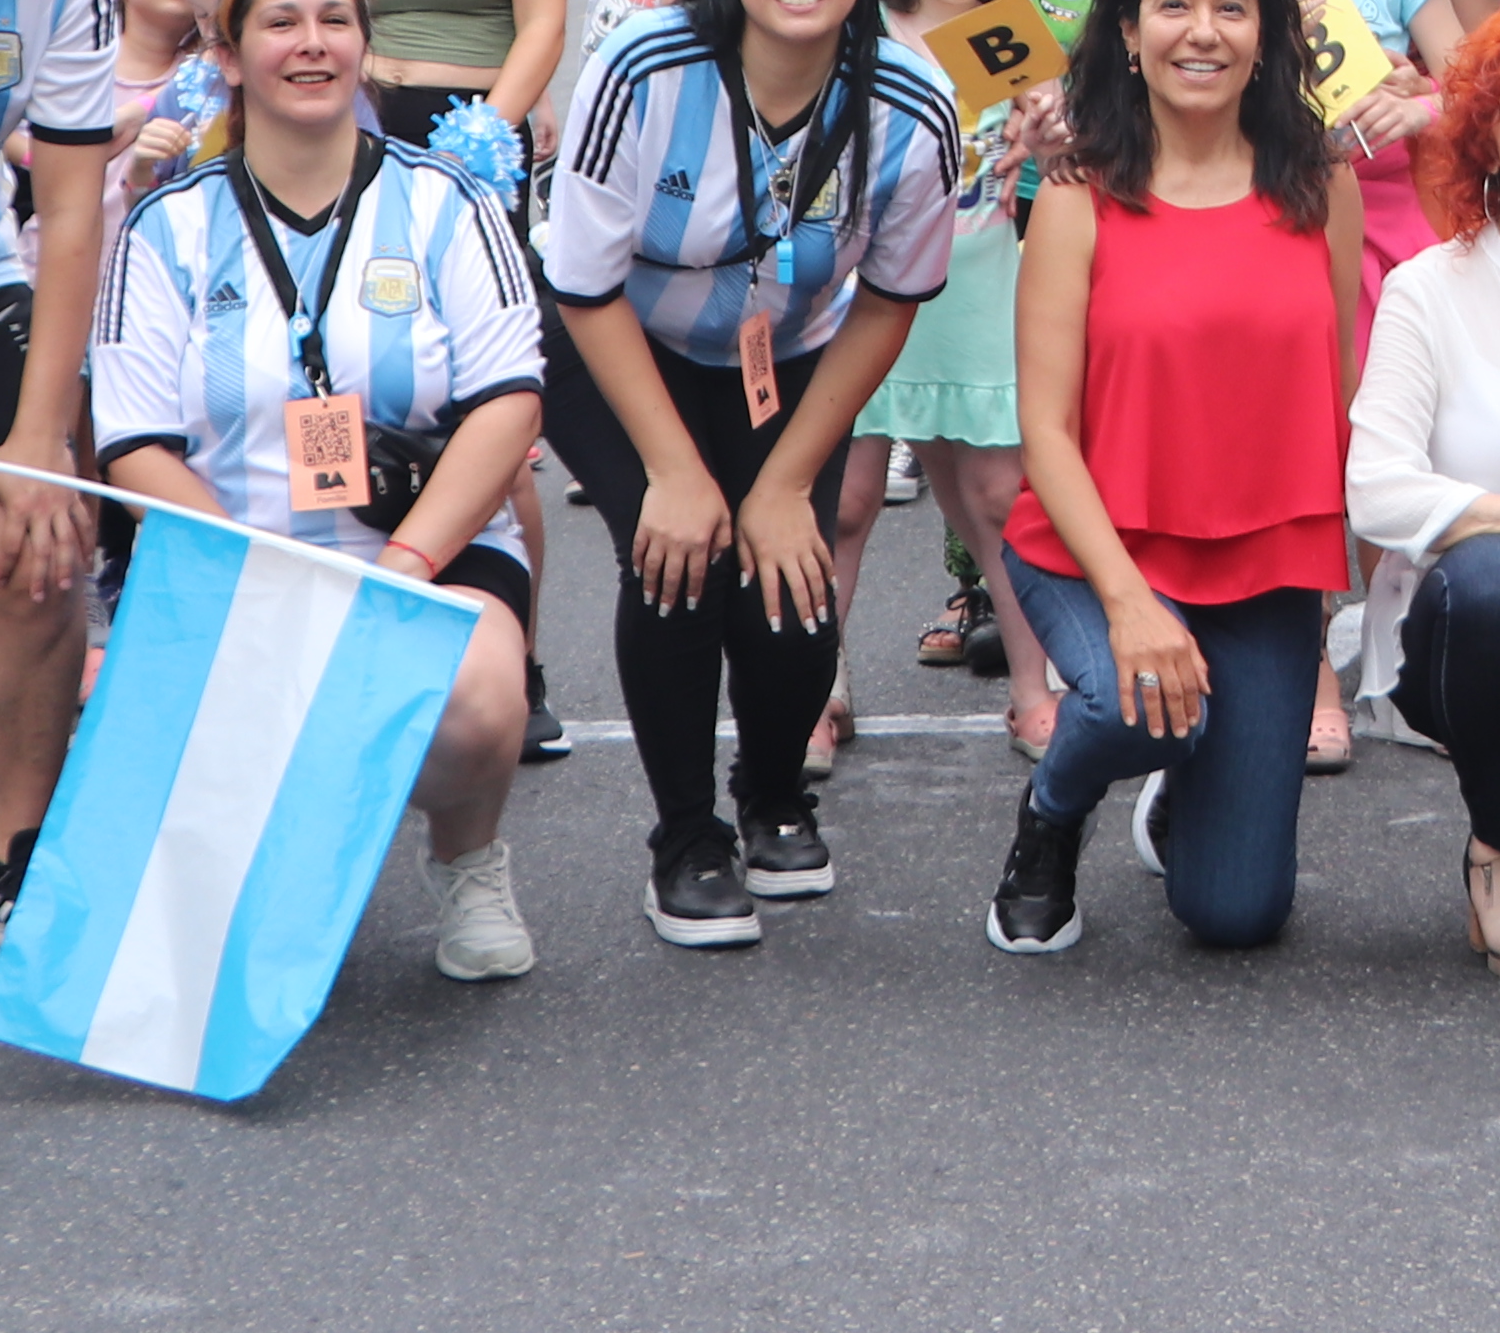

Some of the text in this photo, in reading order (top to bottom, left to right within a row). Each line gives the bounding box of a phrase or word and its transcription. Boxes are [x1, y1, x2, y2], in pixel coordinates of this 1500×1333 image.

[966, 25, 1031, 77] B
[1304, 20, 1346, 84] B
[203, 300, 248, 313] adidas
[316, 472, 347, 490] BA
